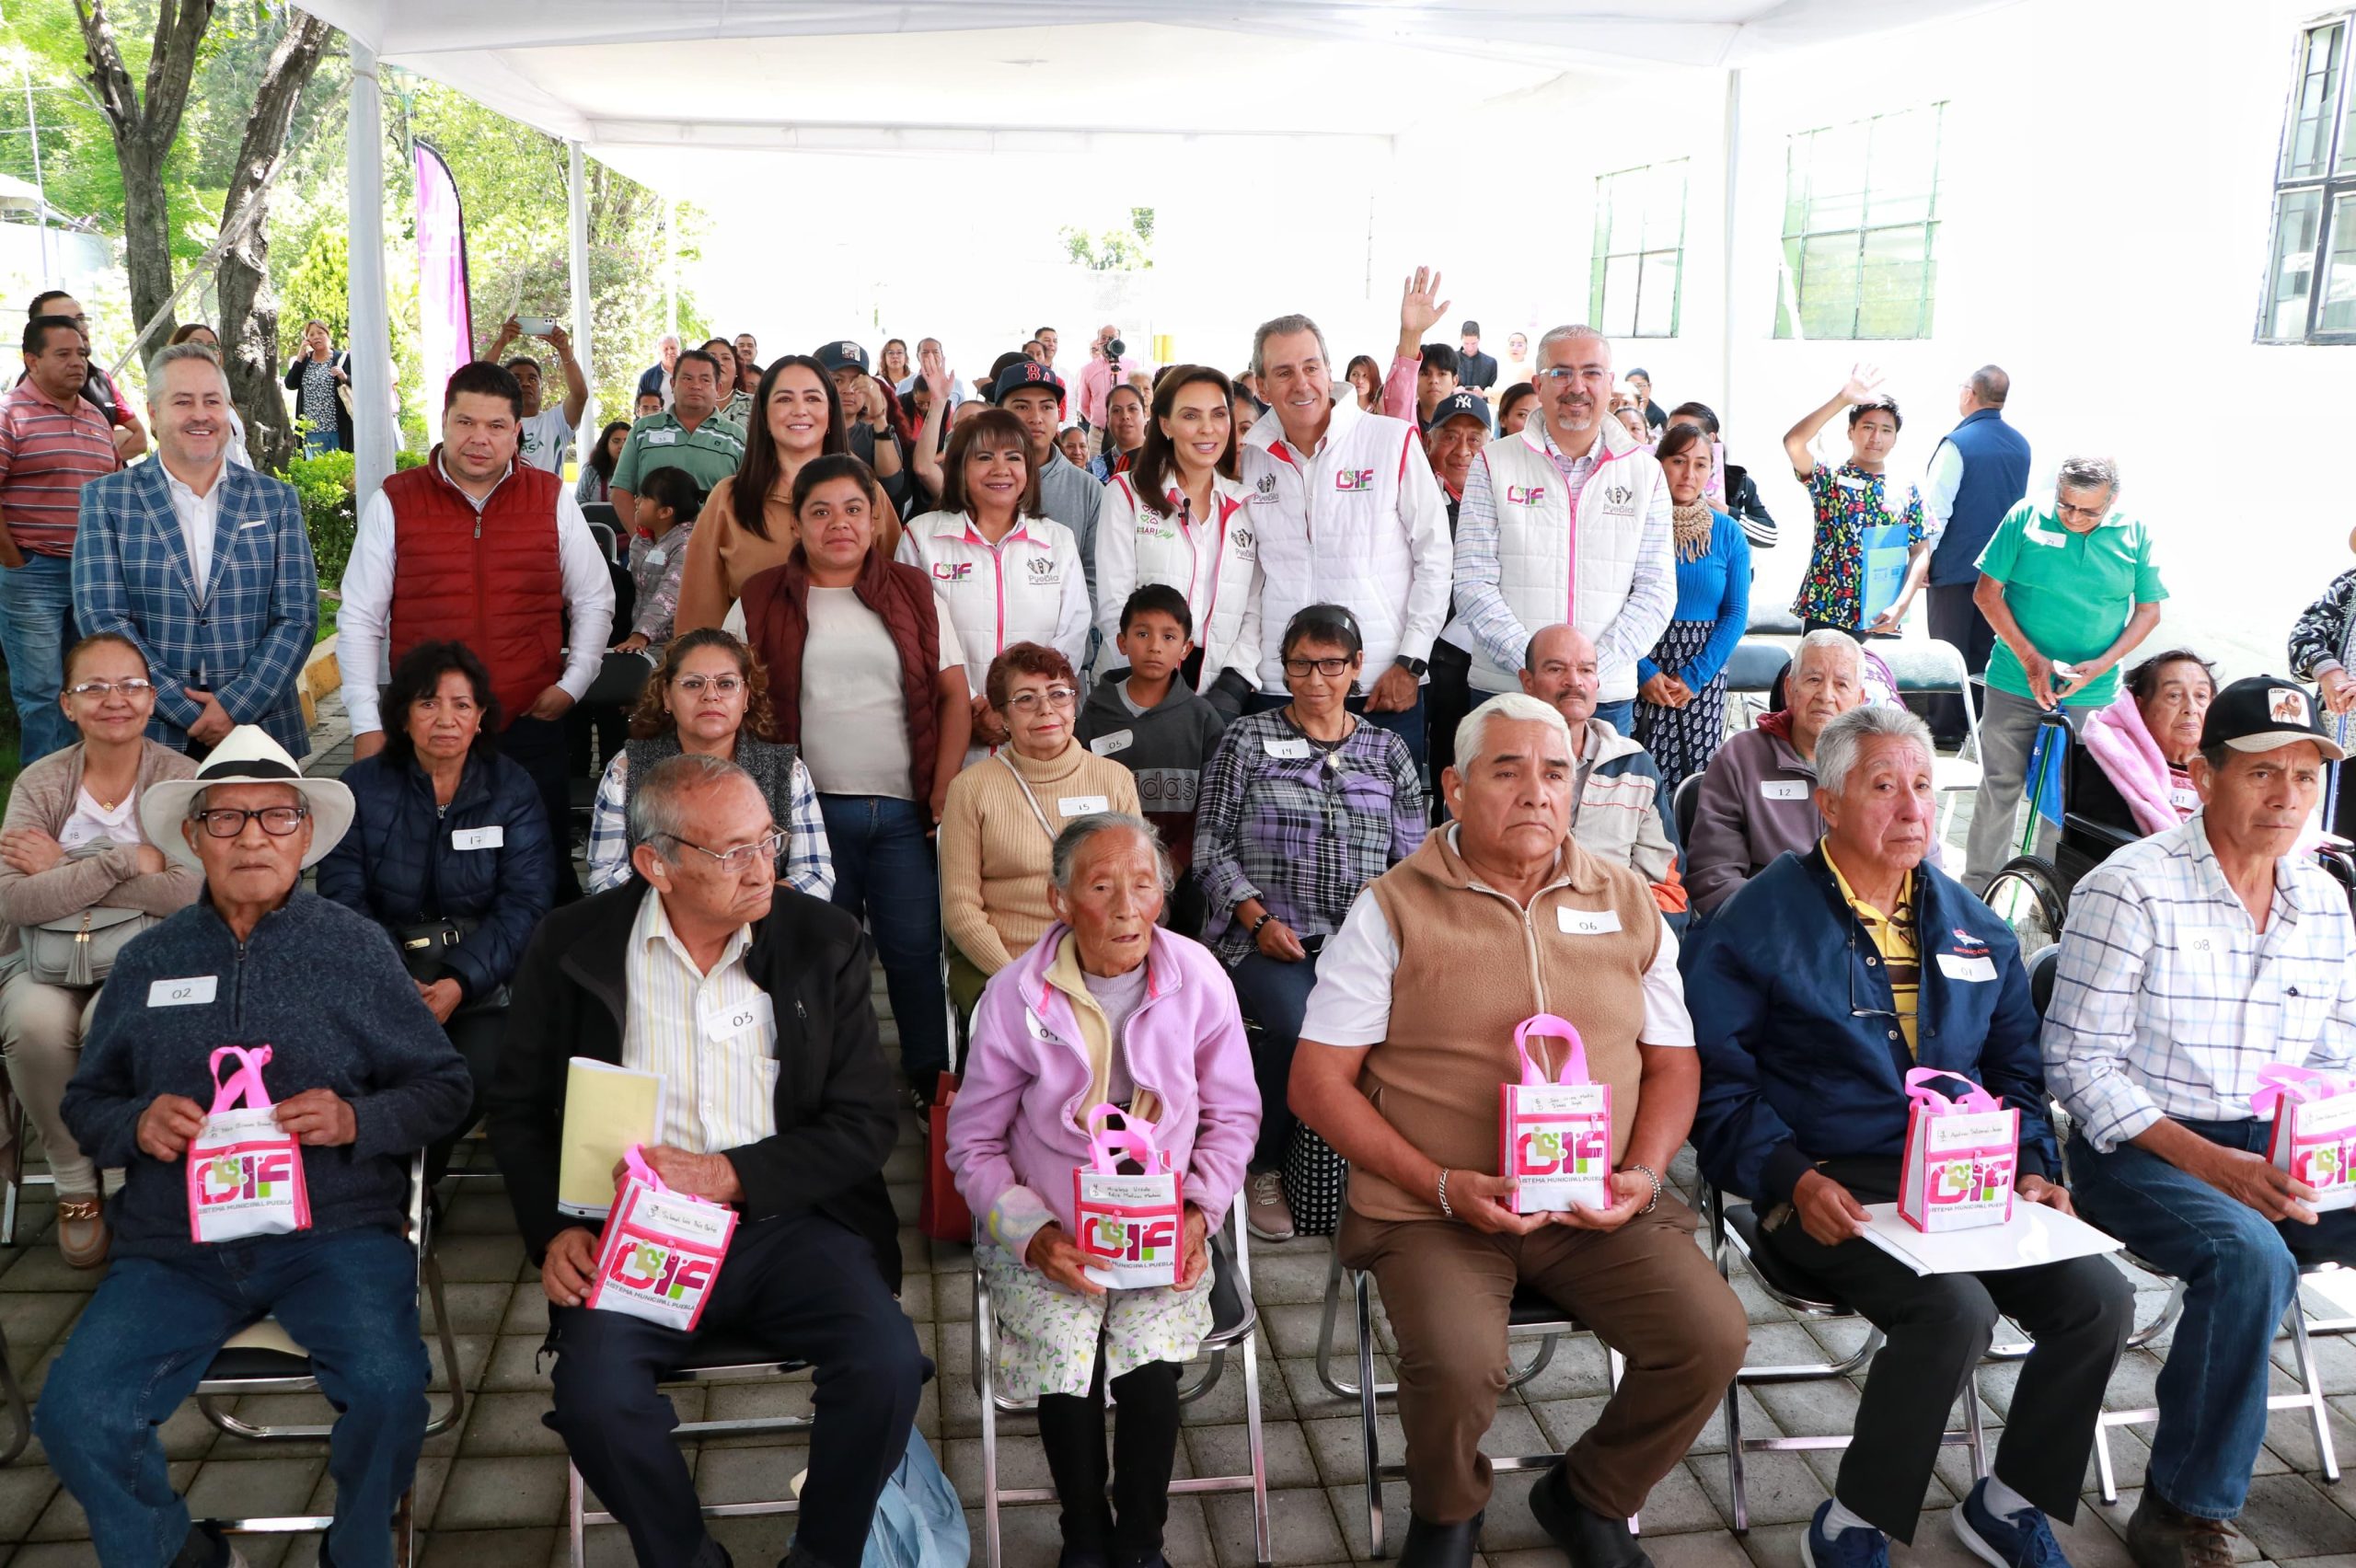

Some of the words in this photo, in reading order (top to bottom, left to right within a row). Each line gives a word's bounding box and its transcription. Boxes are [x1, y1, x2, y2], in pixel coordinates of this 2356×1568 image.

[1024, 363, 1041, 382] B
[1455, 395, 1472, 409] NY
[1108, 740, 1123, 750] 05
[1134, 771, 1196, 801] idas
[1779, 788, 1791, 796] 12
[1079, 802, 1091, 811] 15
[1578, 921, 1598, 930] 06
[2193, 939, 2211, 951] 08
[171, 987, 192, 1000] 02
[733, 1011, 754, 1027] 03
[605, 1280, 634, 1298] SISTEMA
[633, 1291, 671, 1307] MUNICIPAL
[671, 1301, 696, 1311] PUEBLA
